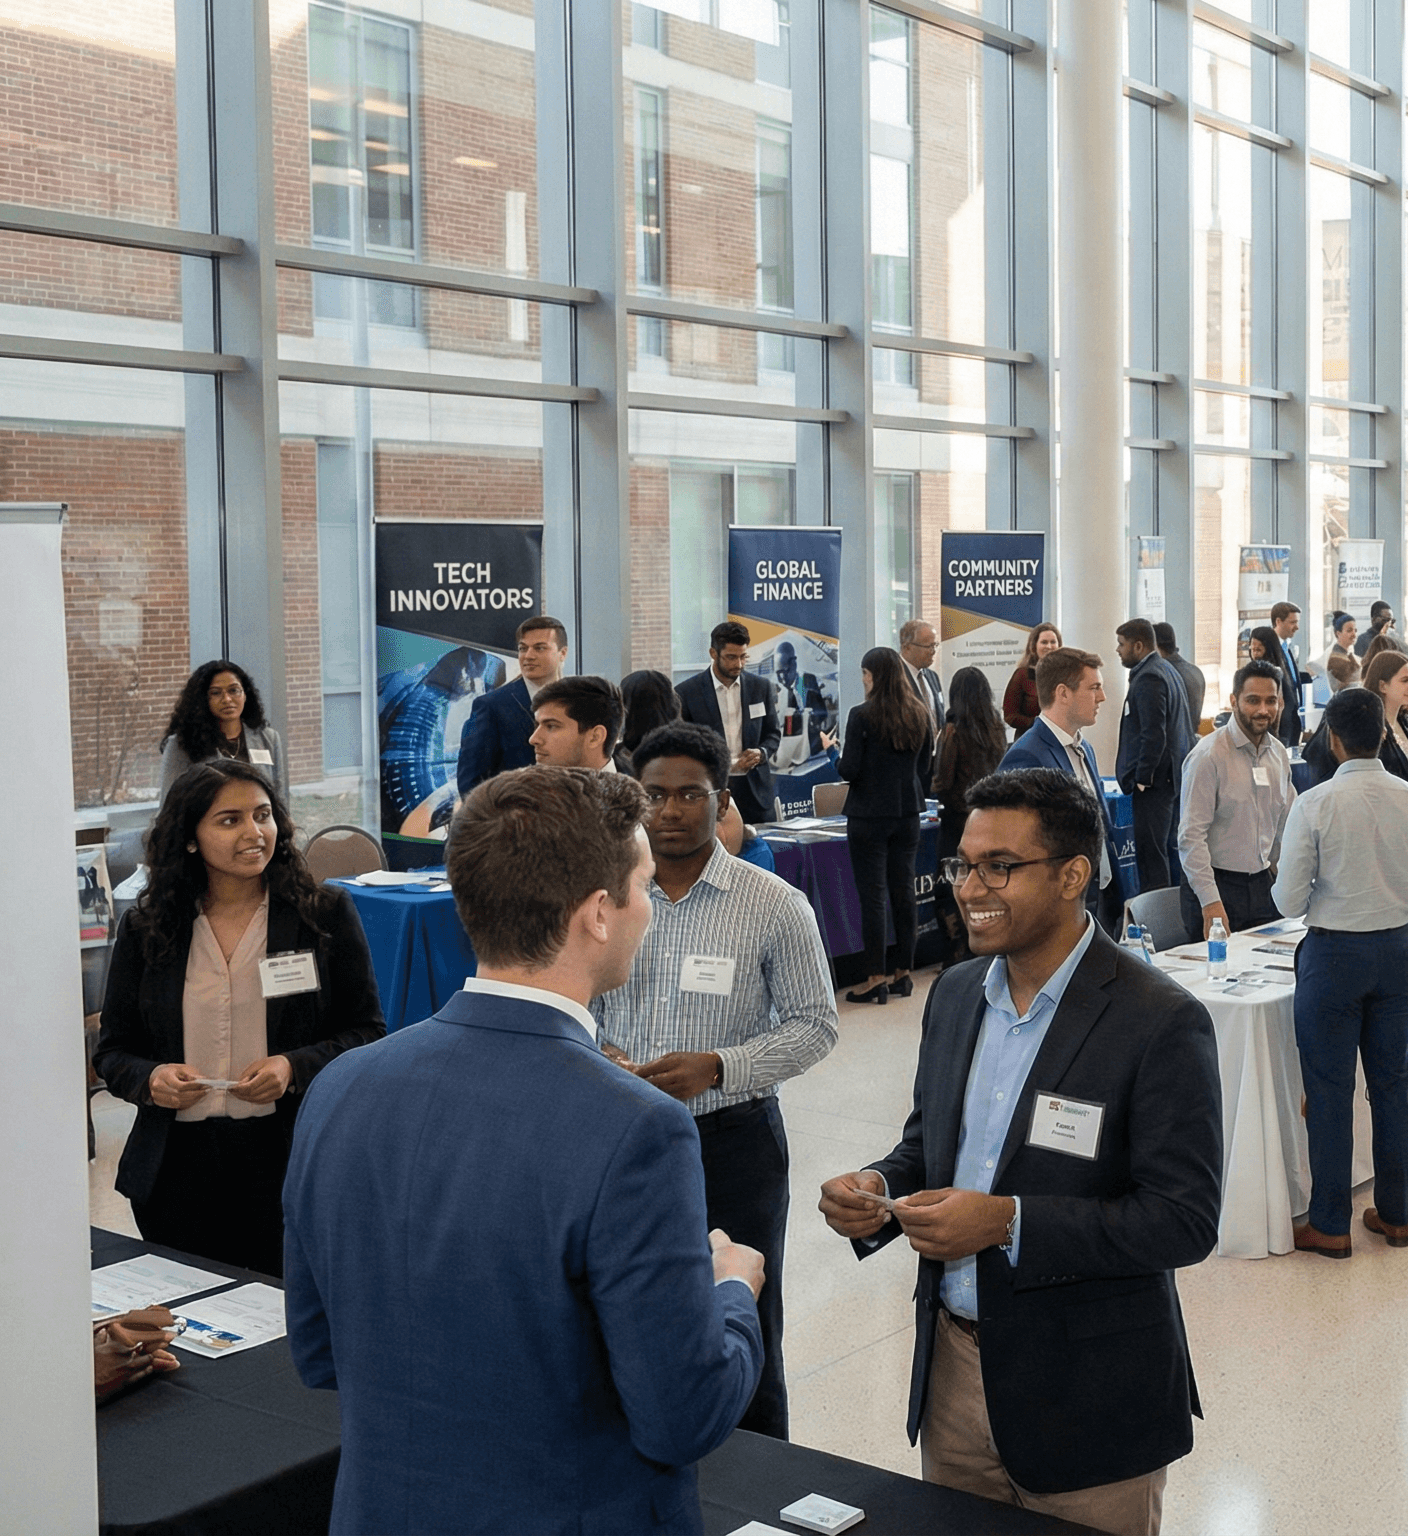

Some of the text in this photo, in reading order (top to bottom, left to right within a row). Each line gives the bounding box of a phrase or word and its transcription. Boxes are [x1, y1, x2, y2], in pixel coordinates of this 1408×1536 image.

[433, 562, 491, 584] TECH
[755, 560, 821, 580] GLOBAL
[948, 559, 1040, 577] COMMUNITY
[753, 581, 824, 602] FINANCE
[955, 579, 1034, 597] PARTNERS
[389, 587, 534, 612] INNOVATORS
